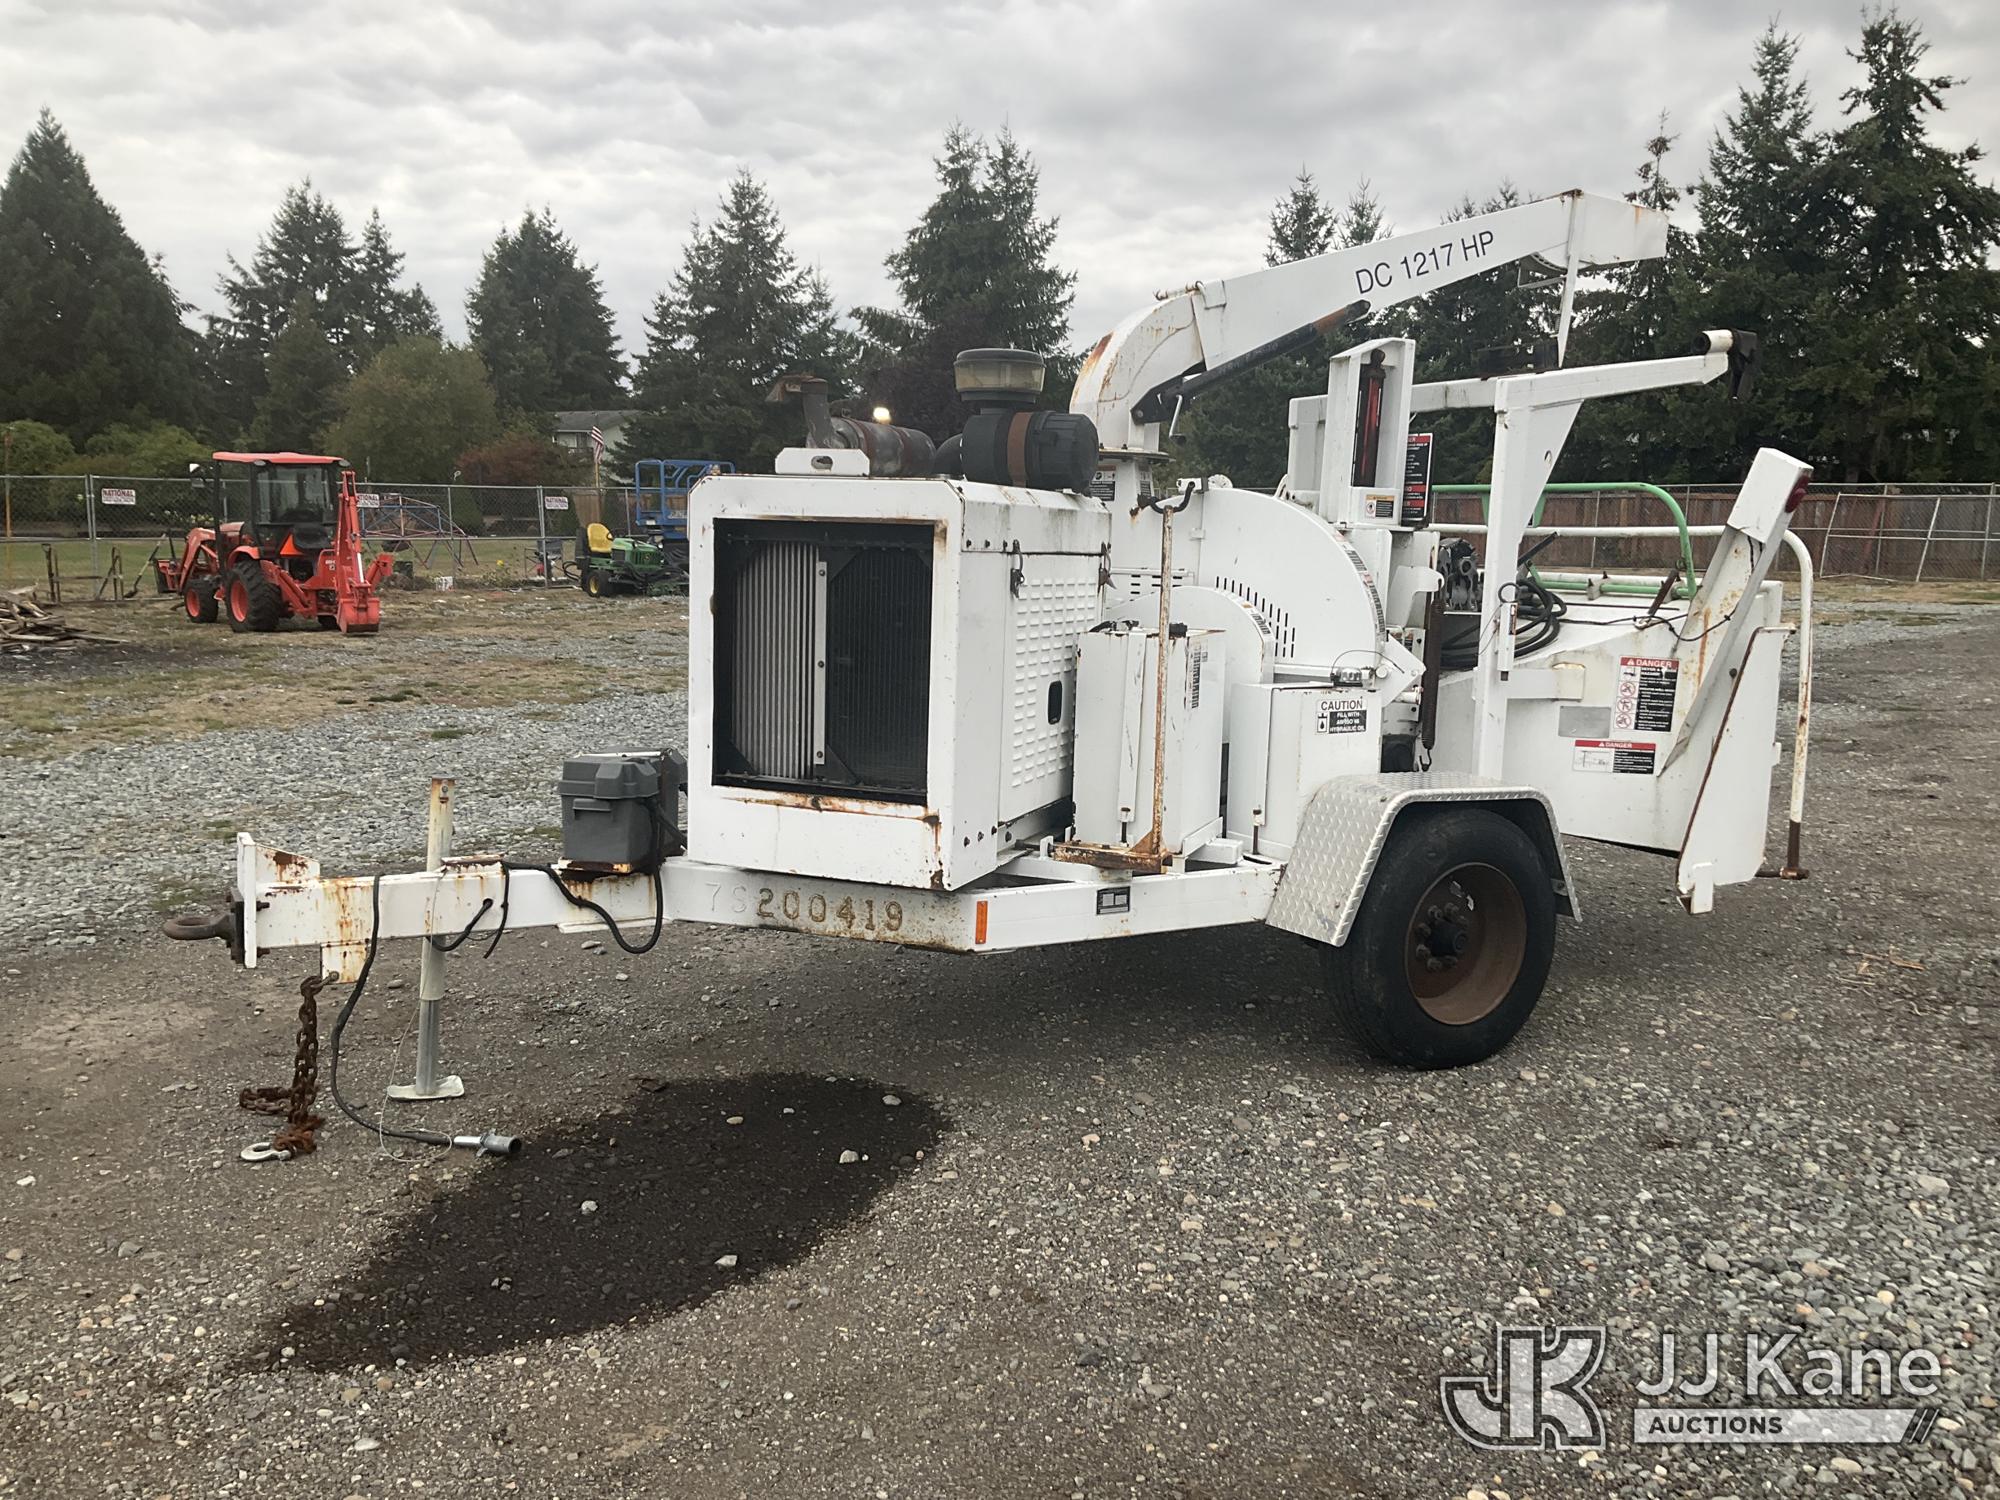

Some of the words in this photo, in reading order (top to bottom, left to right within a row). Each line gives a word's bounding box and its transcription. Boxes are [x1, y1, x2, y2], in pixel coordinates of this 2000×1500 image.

[1355, 262, 1392, 294] DC
[1400, 243, 1453, 279] 1217
[1461, 230, 1494, 261] HP
[103, 489, 133, 497] NATIONAL
[1635, 659, 1673, 668] DANGER
[1320, 700, 1363, 711] CAUTION
